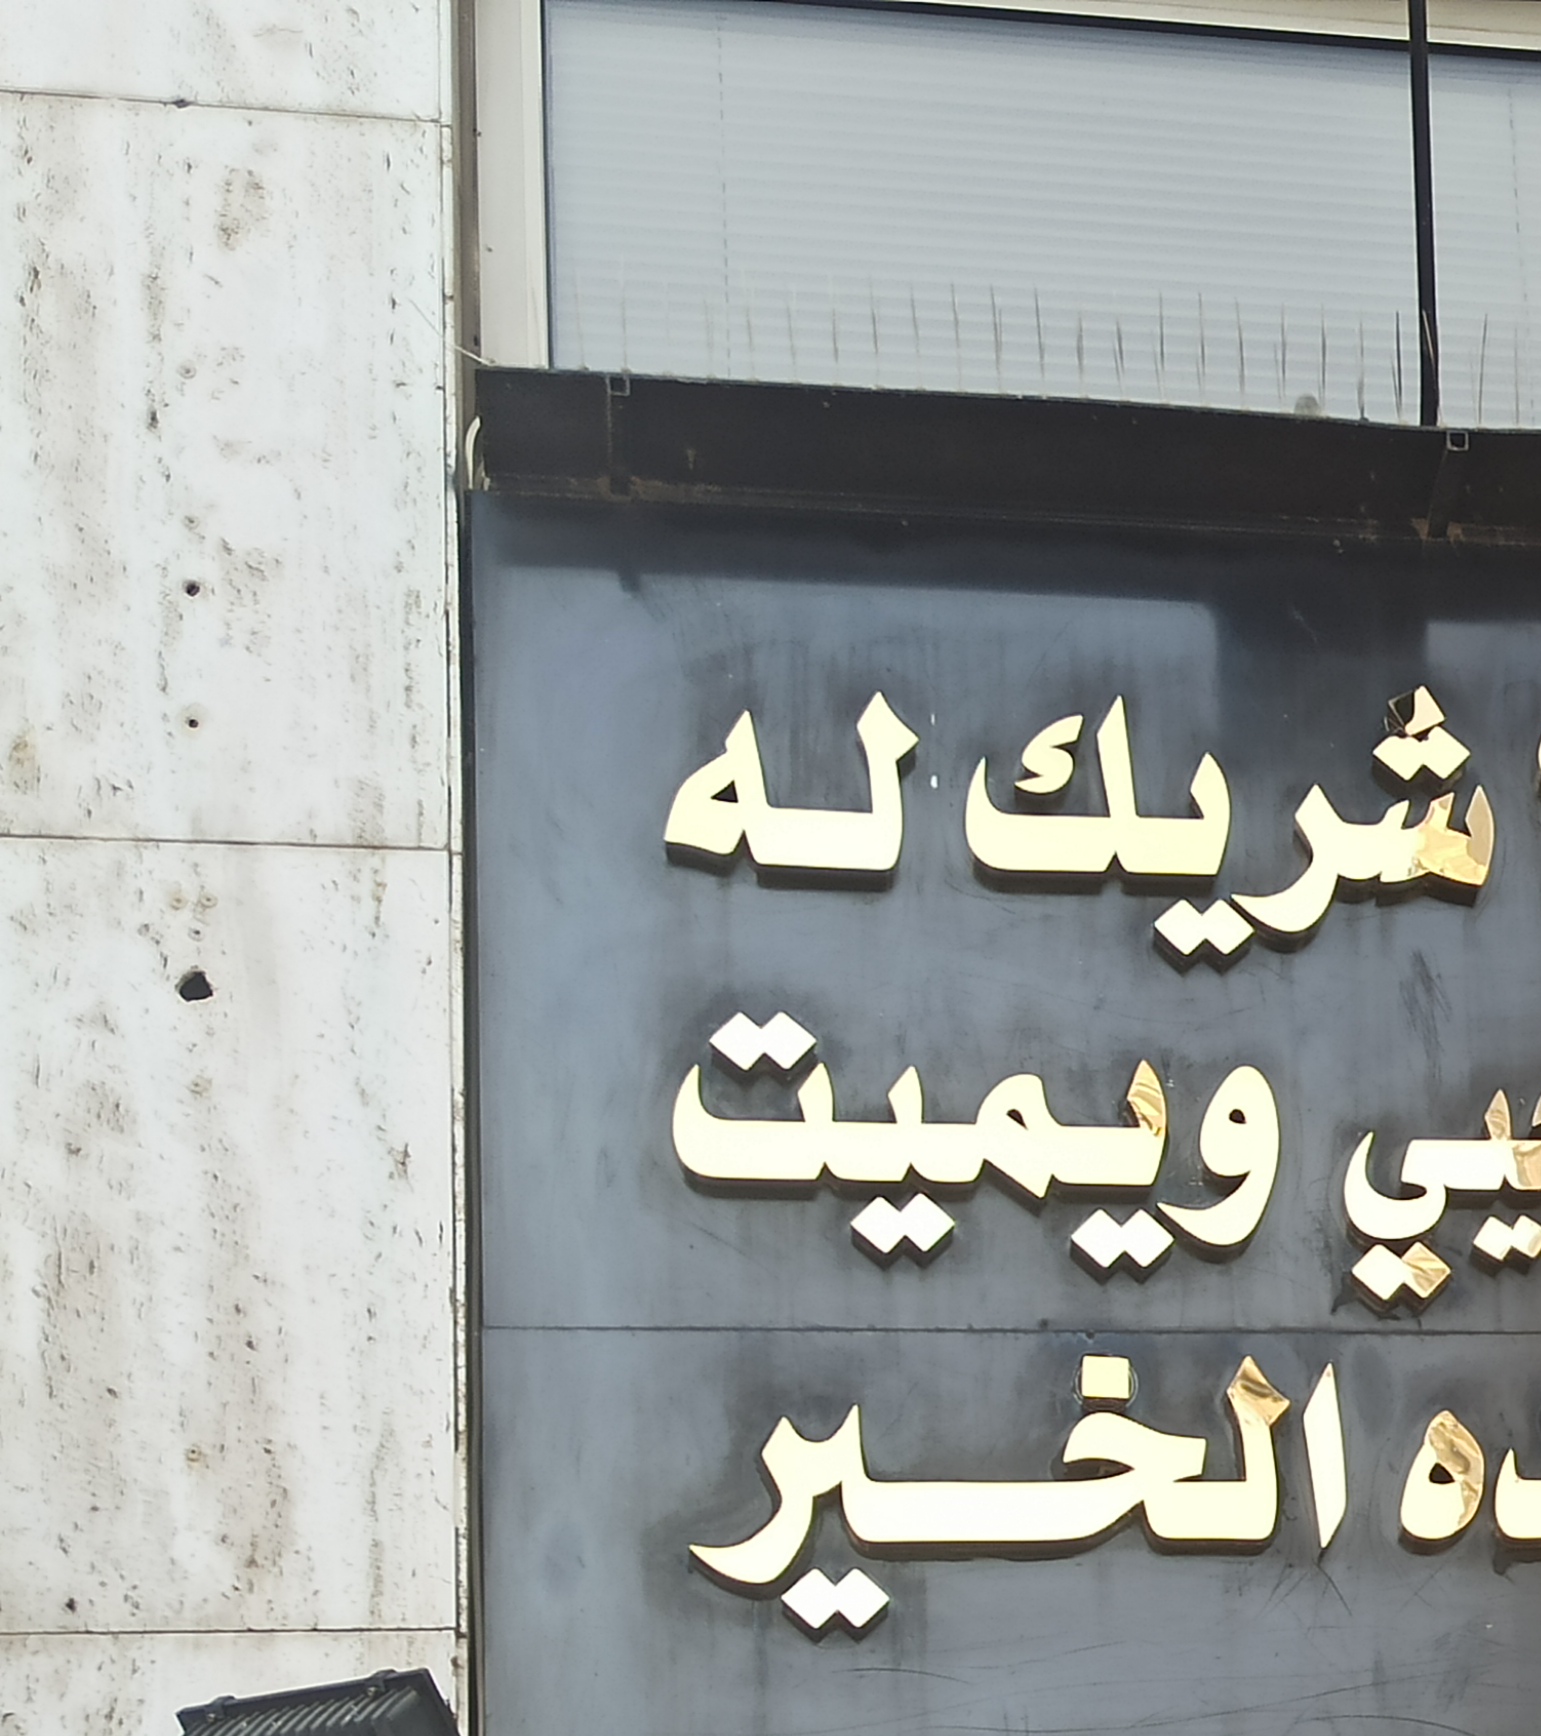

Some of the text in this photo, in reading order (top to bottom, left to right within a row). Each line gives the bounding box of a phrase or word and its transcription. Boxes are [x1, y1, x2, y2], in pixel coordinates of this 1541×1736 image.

[664, 690, 920, 885] له
[963, 684, 1497, 968] شريك
[670, 1010, 1282, 1287] ويميت
[686, 1353, 1350, 1630] الخير
